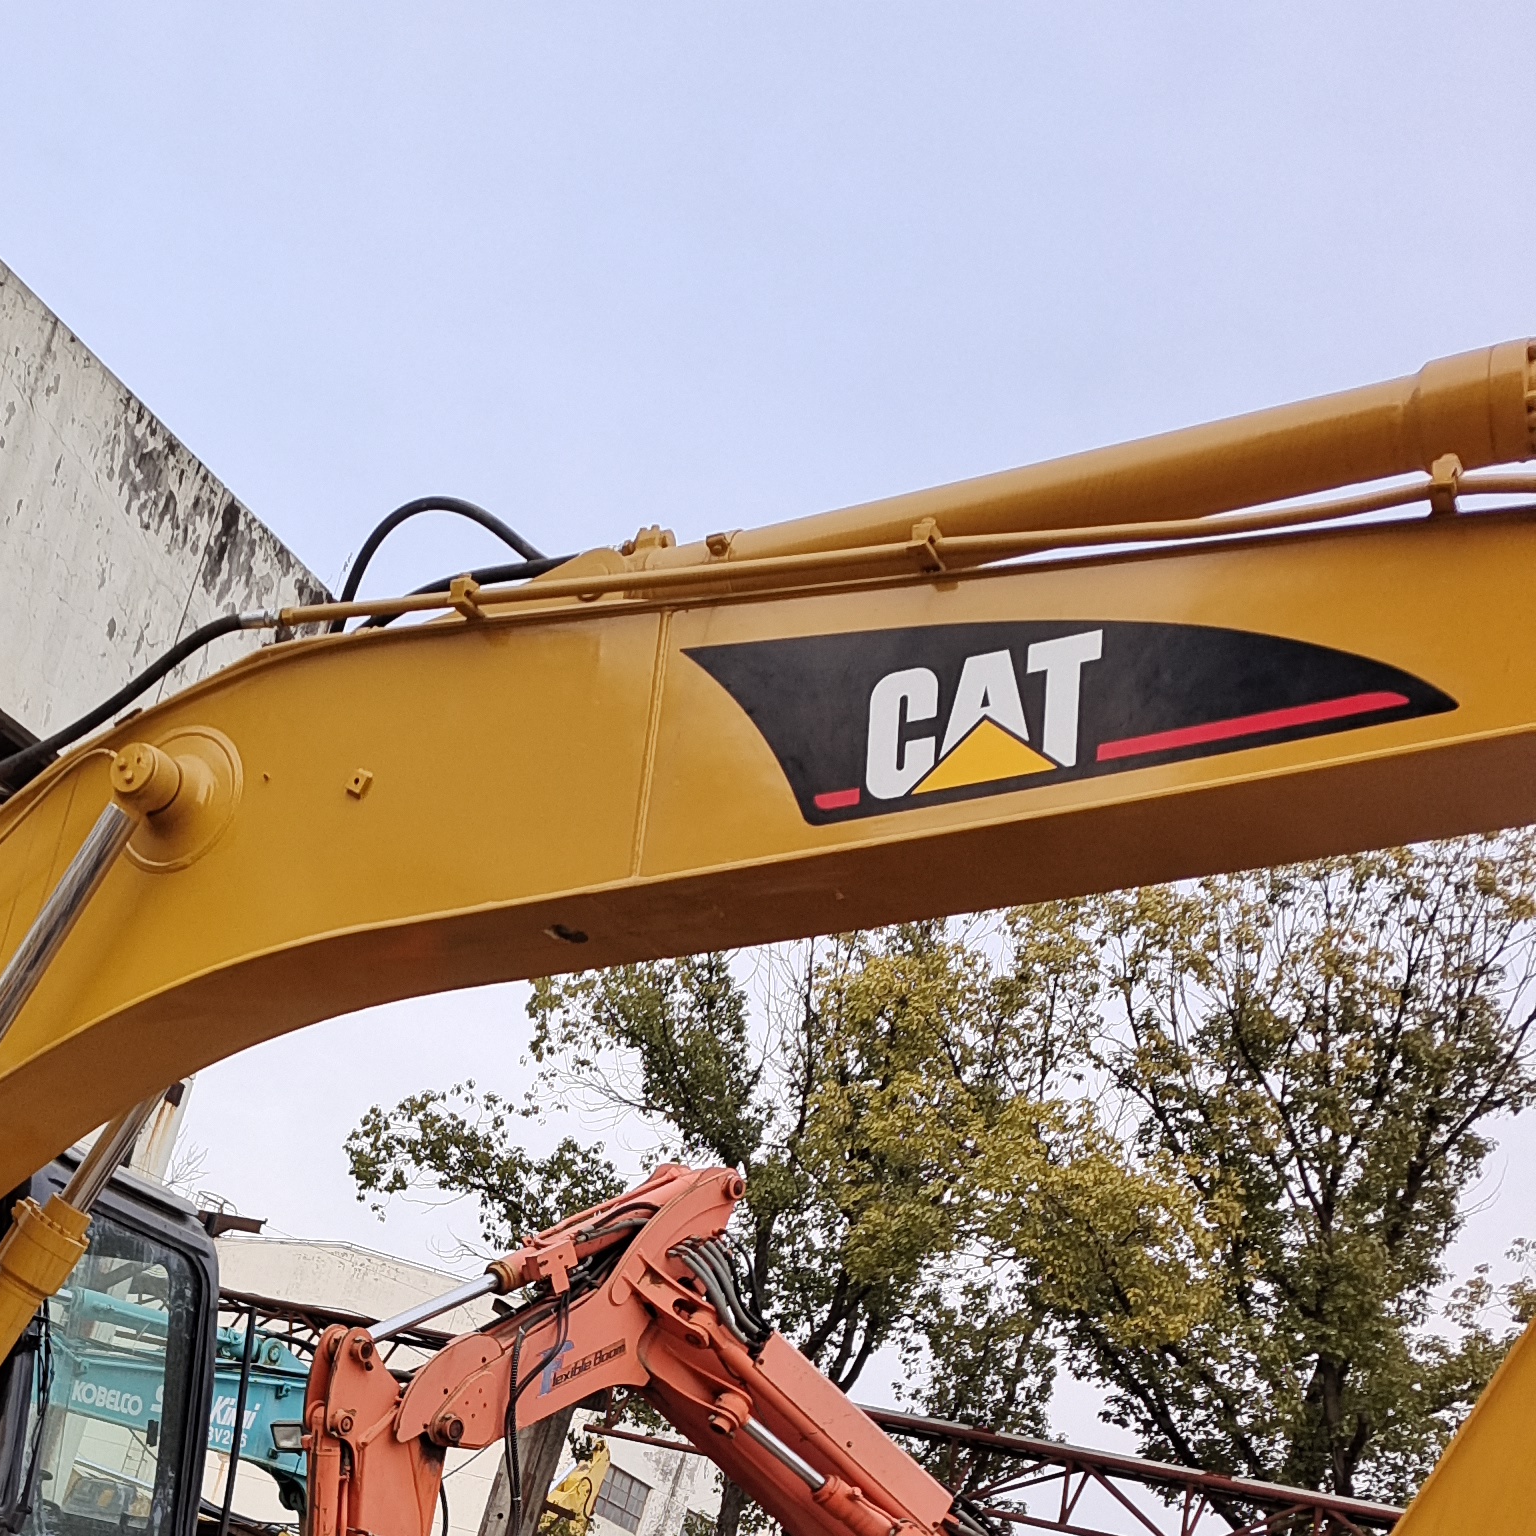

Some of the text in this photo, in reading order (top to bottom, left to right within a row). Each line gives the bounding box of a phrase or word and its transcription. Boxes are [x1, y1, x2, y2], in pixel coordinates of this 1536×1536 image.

[865, 629, 1104, 800] CAT
[594, 1343, 626, 1367] Boom
[71, 1379, 143, 1416] KOBELCO
